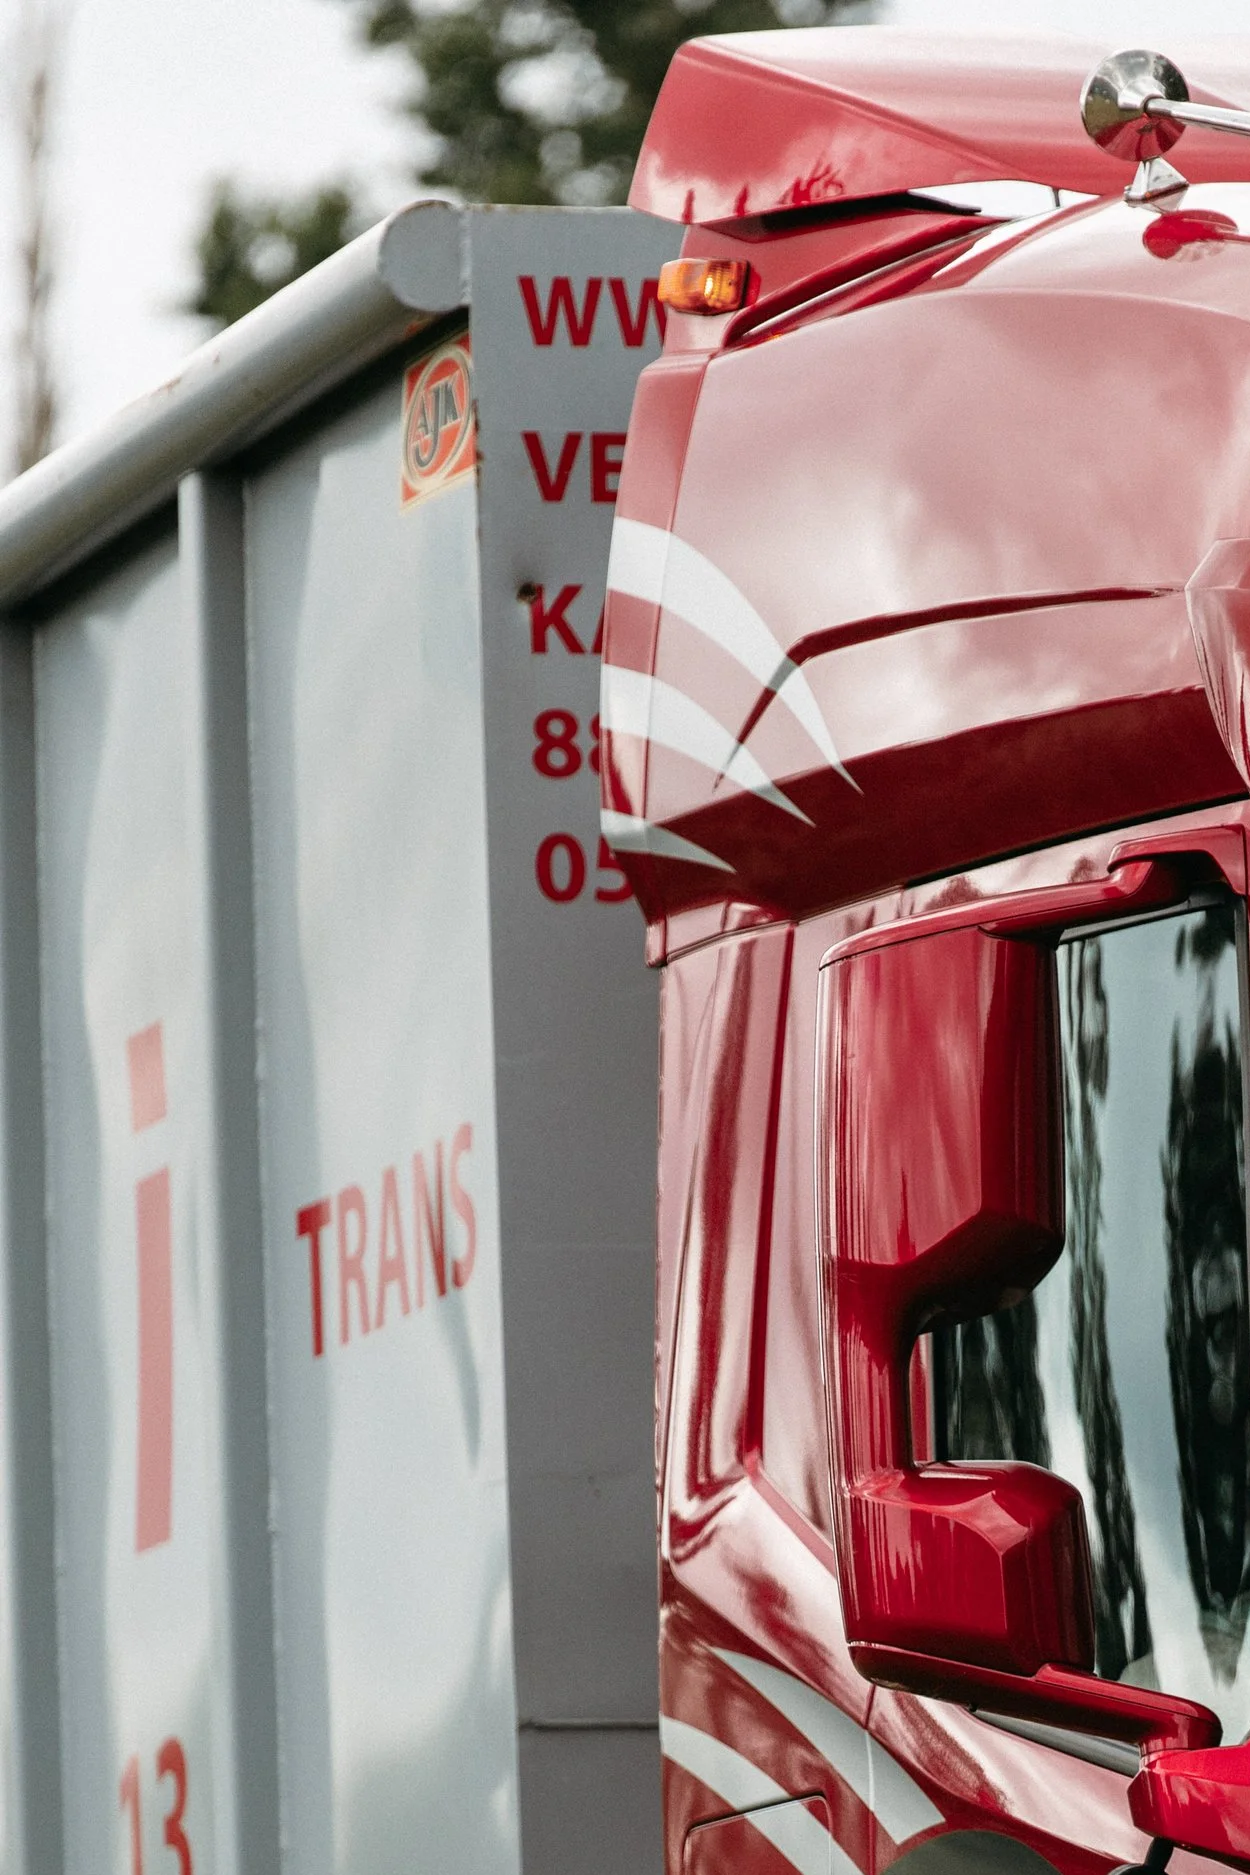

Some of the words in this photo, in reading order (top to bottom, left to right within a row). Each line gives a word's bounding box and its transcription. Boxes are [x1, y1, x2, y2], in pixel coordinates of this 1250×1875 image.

[520, 431, 628, 503] VE
[529, 582, 605, 655] K
[532, 708, 600, 779] 8
[295, 1120, 477, 1359] TRANS
